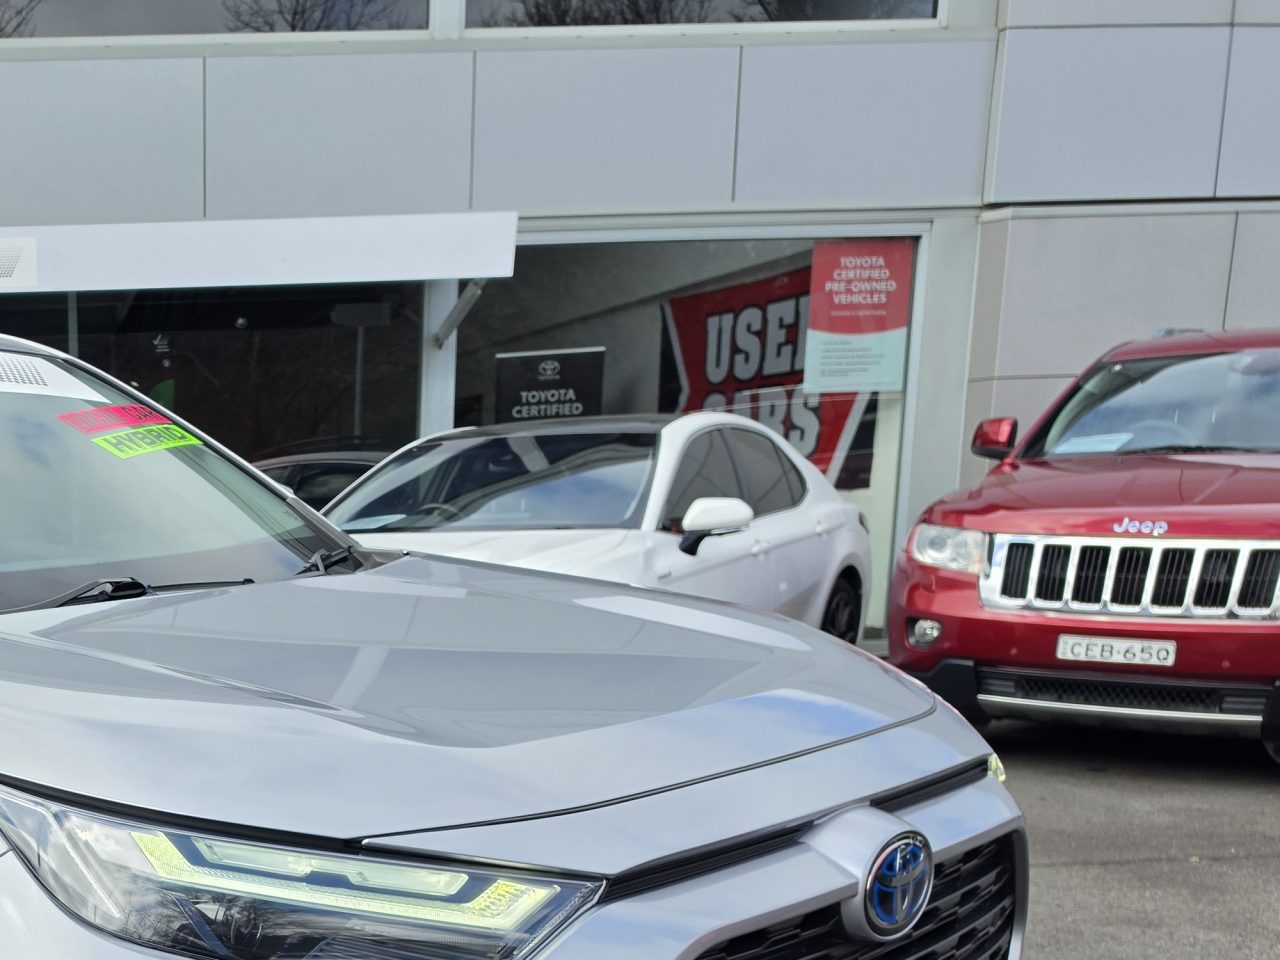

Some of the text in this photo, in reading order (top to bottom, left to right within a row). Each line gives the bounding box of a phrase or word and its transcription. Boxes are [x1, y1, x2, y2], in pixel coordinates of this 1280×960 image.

[840, 256, 885, 267] TOYOTA
[833, 268, 890, 280] CERTIFIED
[825, 280, 897, 292] PRE-OWNED
[833, 293, 887, 304] VEHICLES
[520, 388, 576, 403] TOYOTA
[511, 402, 584, 418] CERTIFIED
[702, 385, 820, 458] RS
[103, 426, 191, 454] HYBRID
[1113, 517, 1168, 536] Jeep
